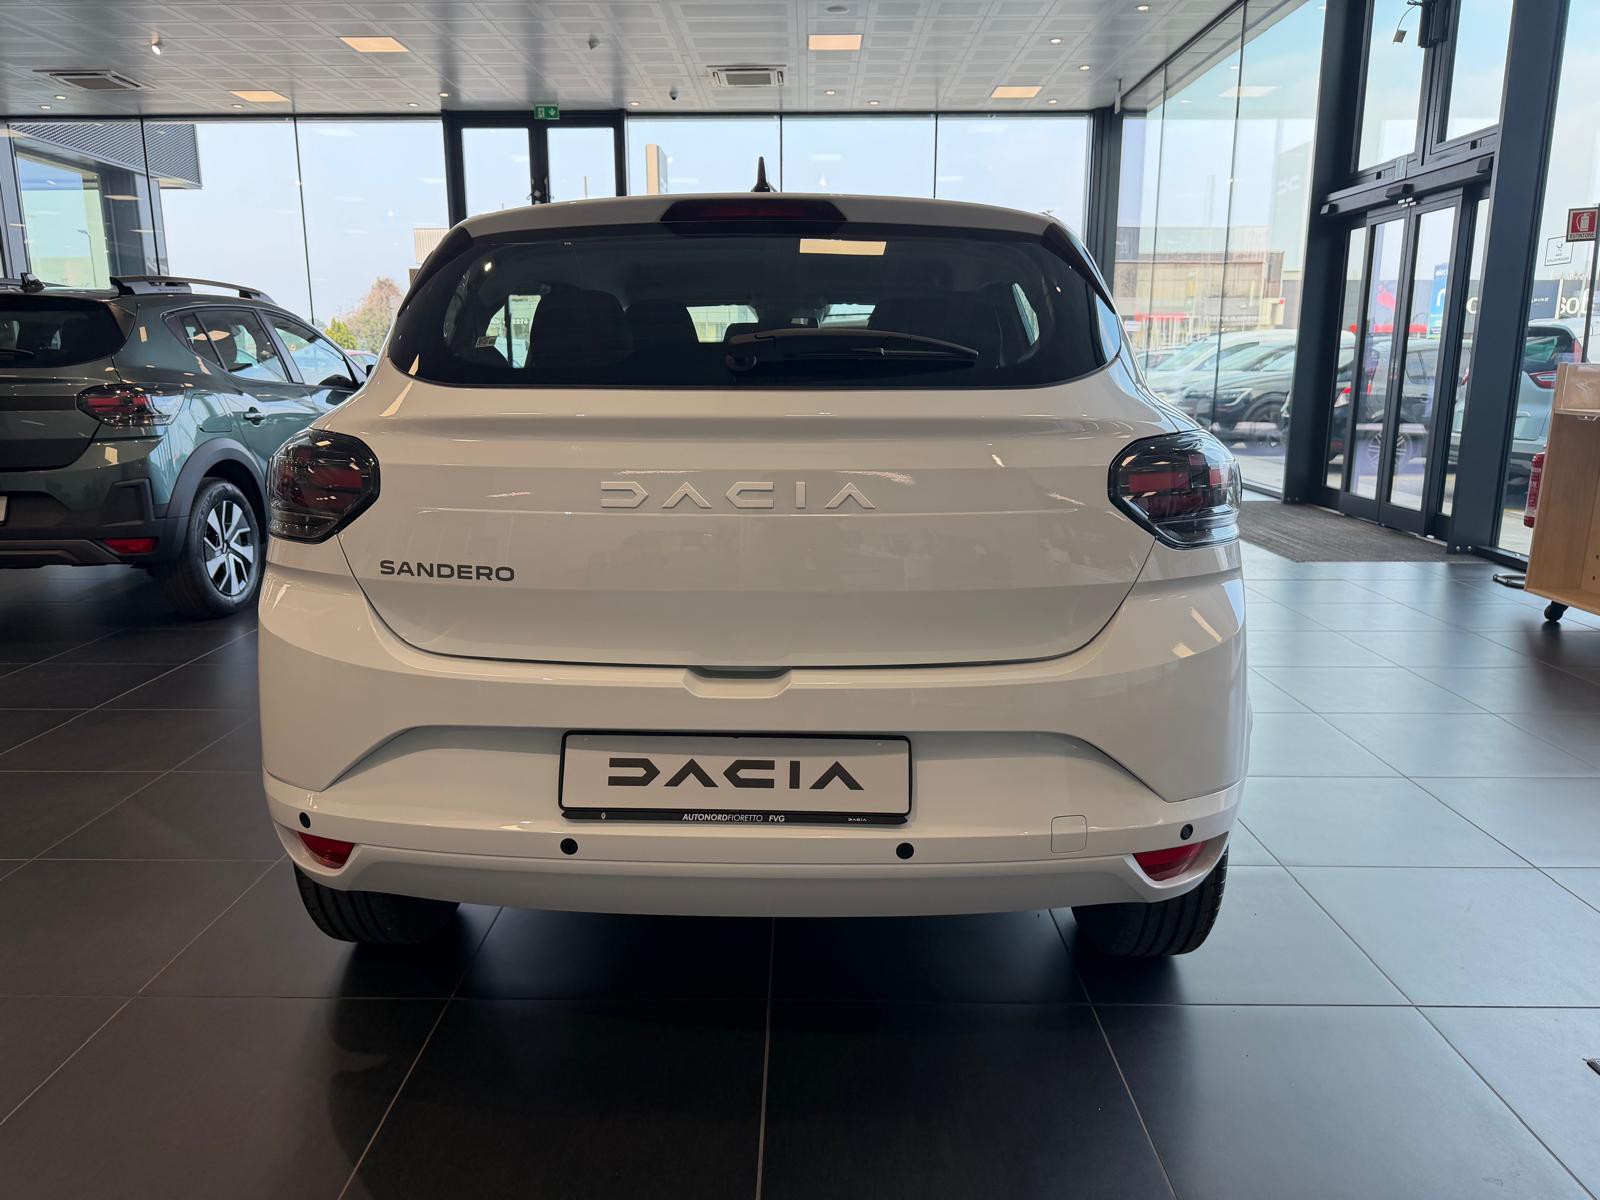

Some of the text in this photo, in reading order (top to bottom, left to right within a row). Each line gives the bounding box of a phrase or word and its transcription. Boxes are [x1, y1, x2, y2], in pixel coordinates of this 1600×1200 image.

[600, 481, 876, 510] DACIA
[379, 559, 515, 582] SANDERO
[607, 757, 865, 791] DACIA
[768, 814, 785, 823] FVG
